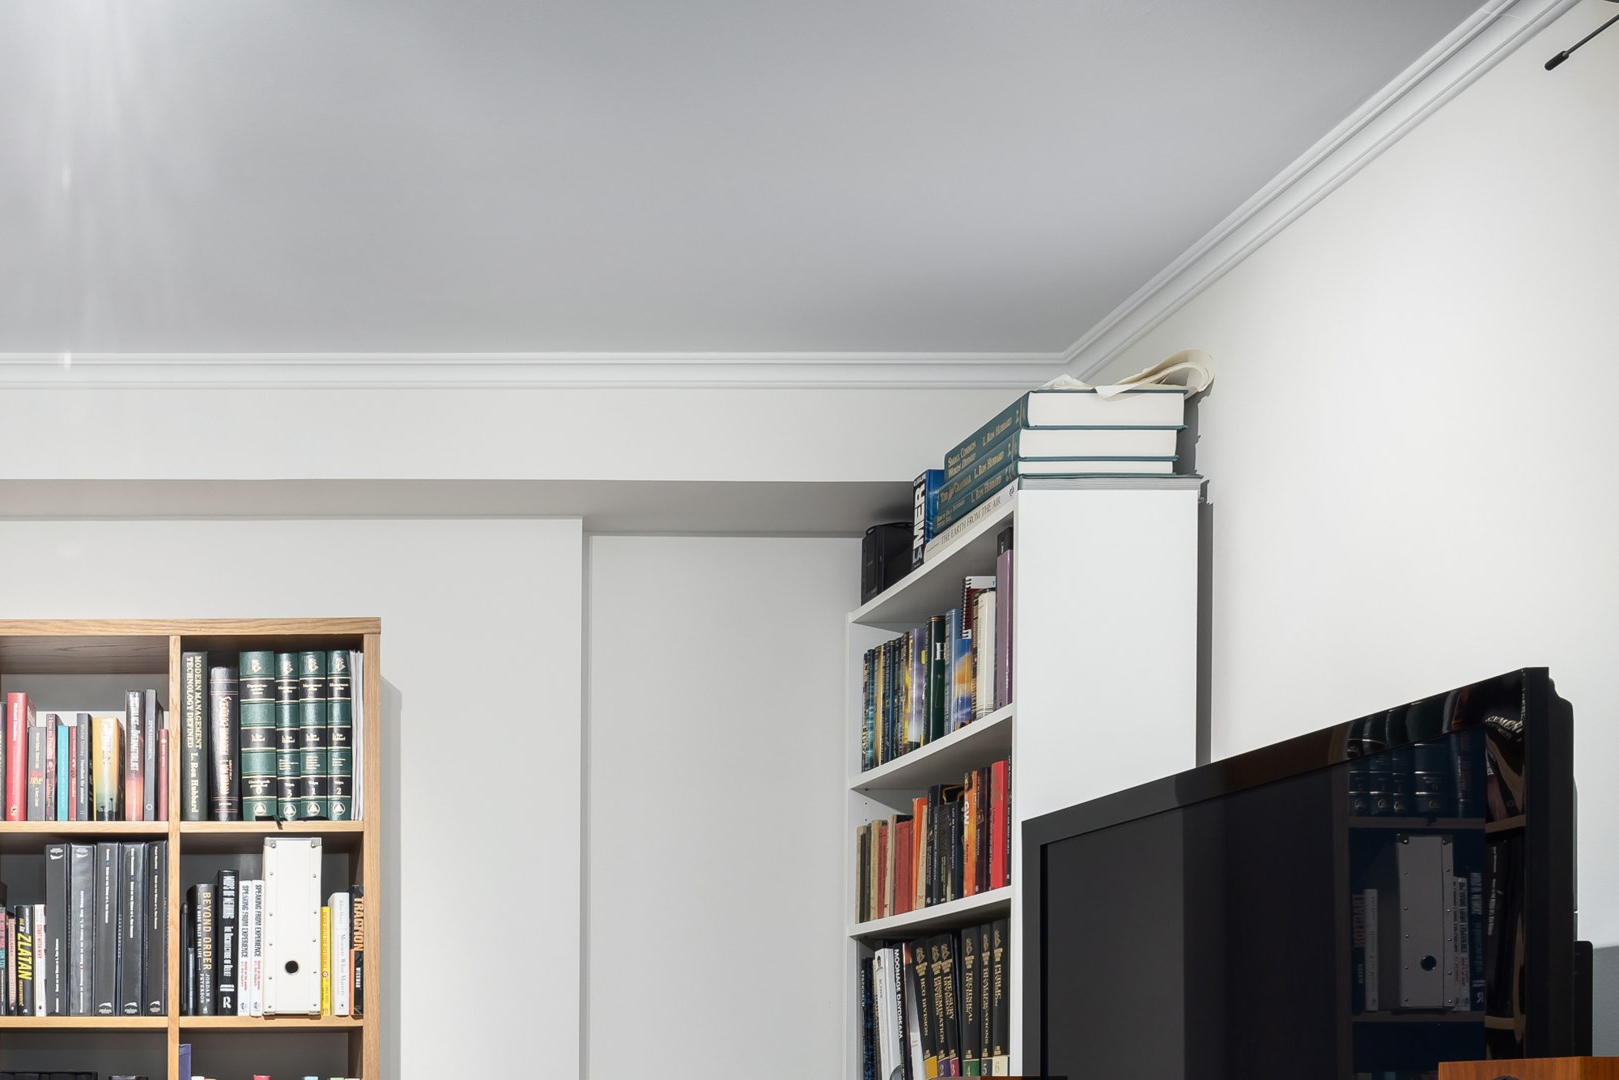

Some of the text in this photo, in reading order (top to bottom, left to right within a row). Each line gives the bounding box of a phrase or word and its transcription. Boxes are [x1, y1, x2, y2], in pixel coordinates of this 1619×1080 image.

[913, 482, 925, 561] LA MER
[941, 496, 1001, 544] THE EARTH FROM THE AIR
[203, 892, 211, 969] BEYOND ORDER
[353, 897, 363, 951] TRACTION
[17, 933, 32, 980] ZLATAN
